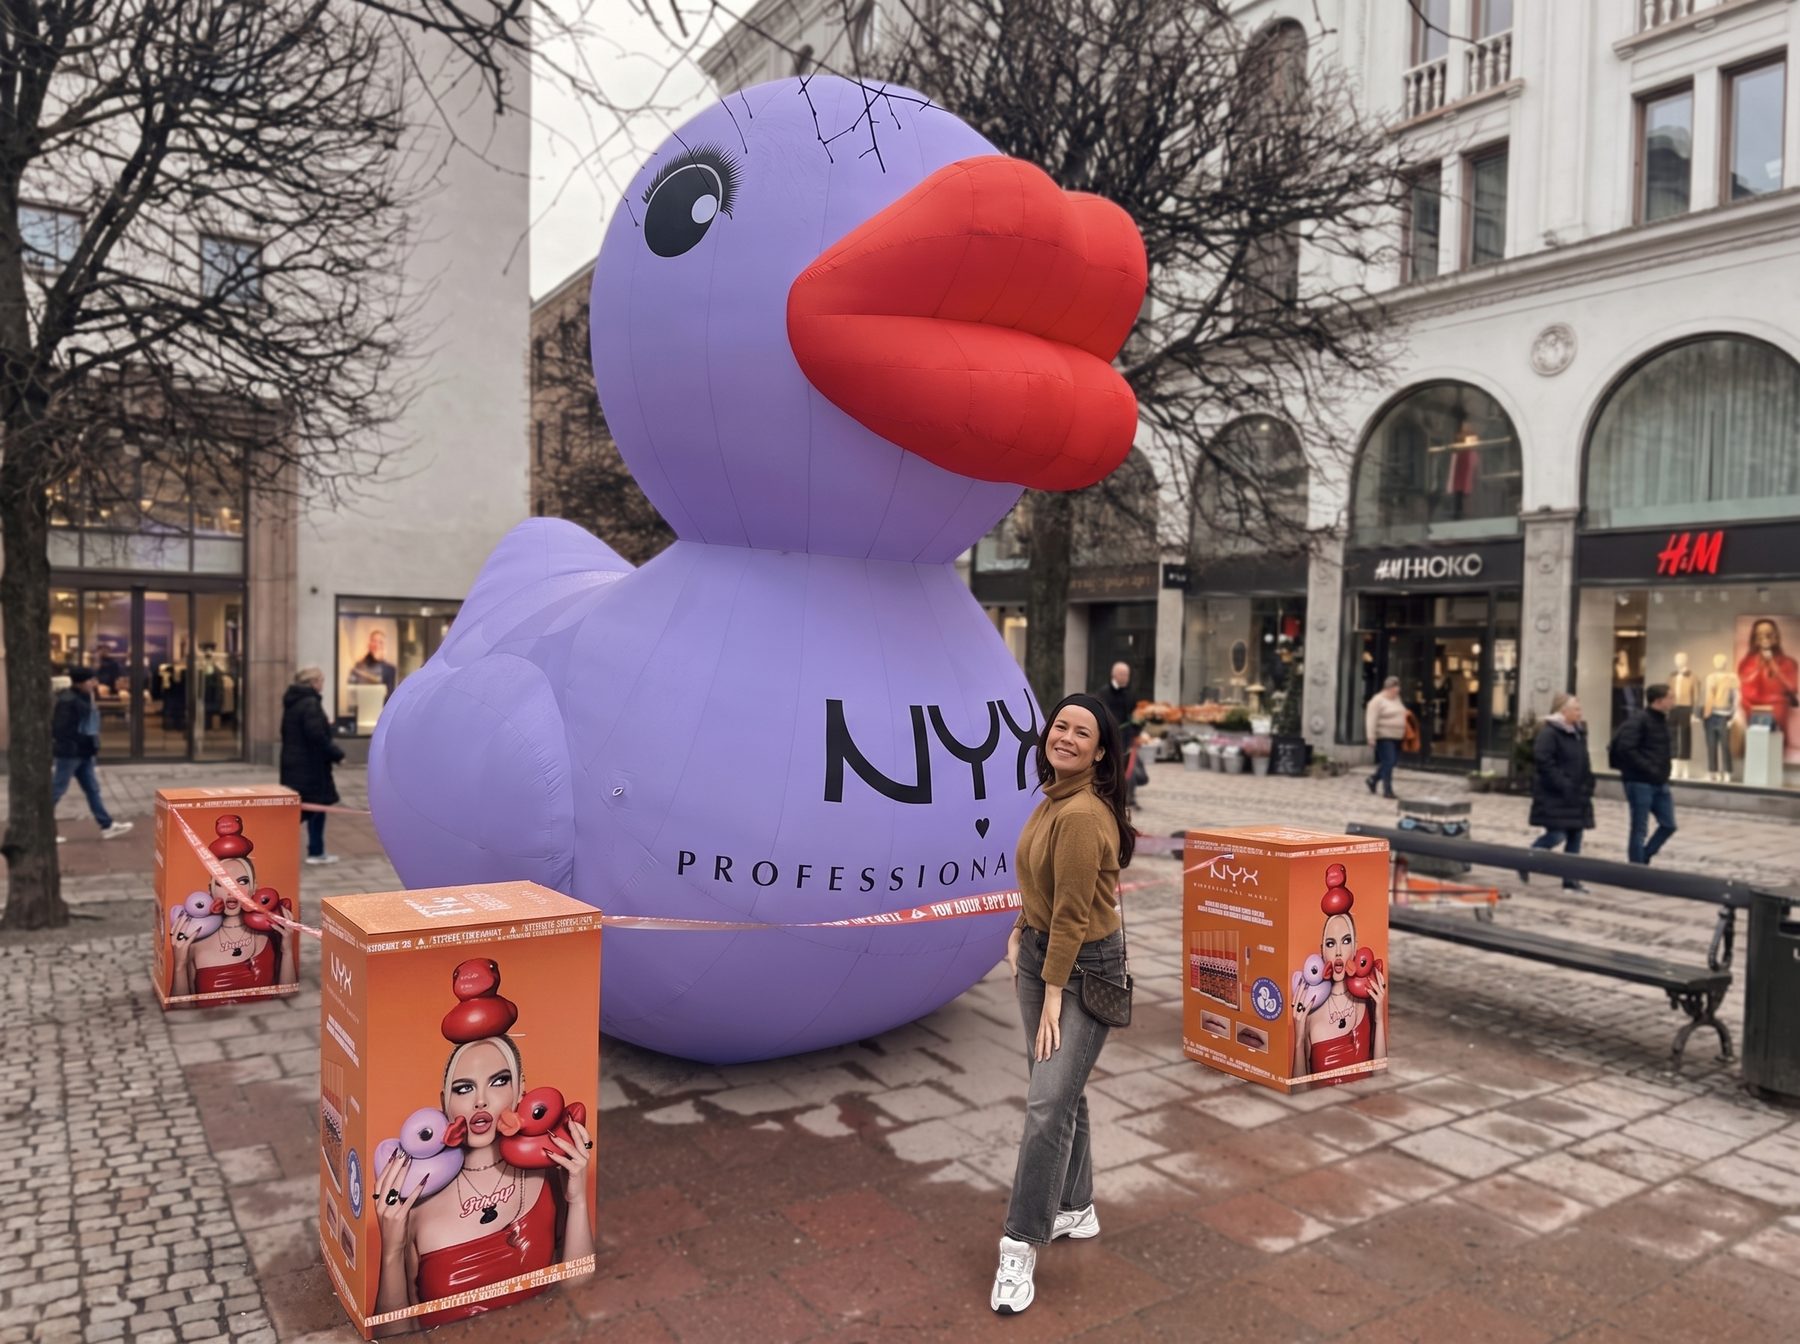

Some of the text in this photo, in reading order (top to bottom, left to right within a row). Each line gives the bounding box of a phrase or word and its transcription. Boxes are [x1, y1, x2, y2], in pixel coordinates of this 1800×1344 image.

[1657, 530, 1724, 576] H&M
[677, 850, 1008, 893] PROFESSIONA
[1210, 864, 1259, 887] NYX
